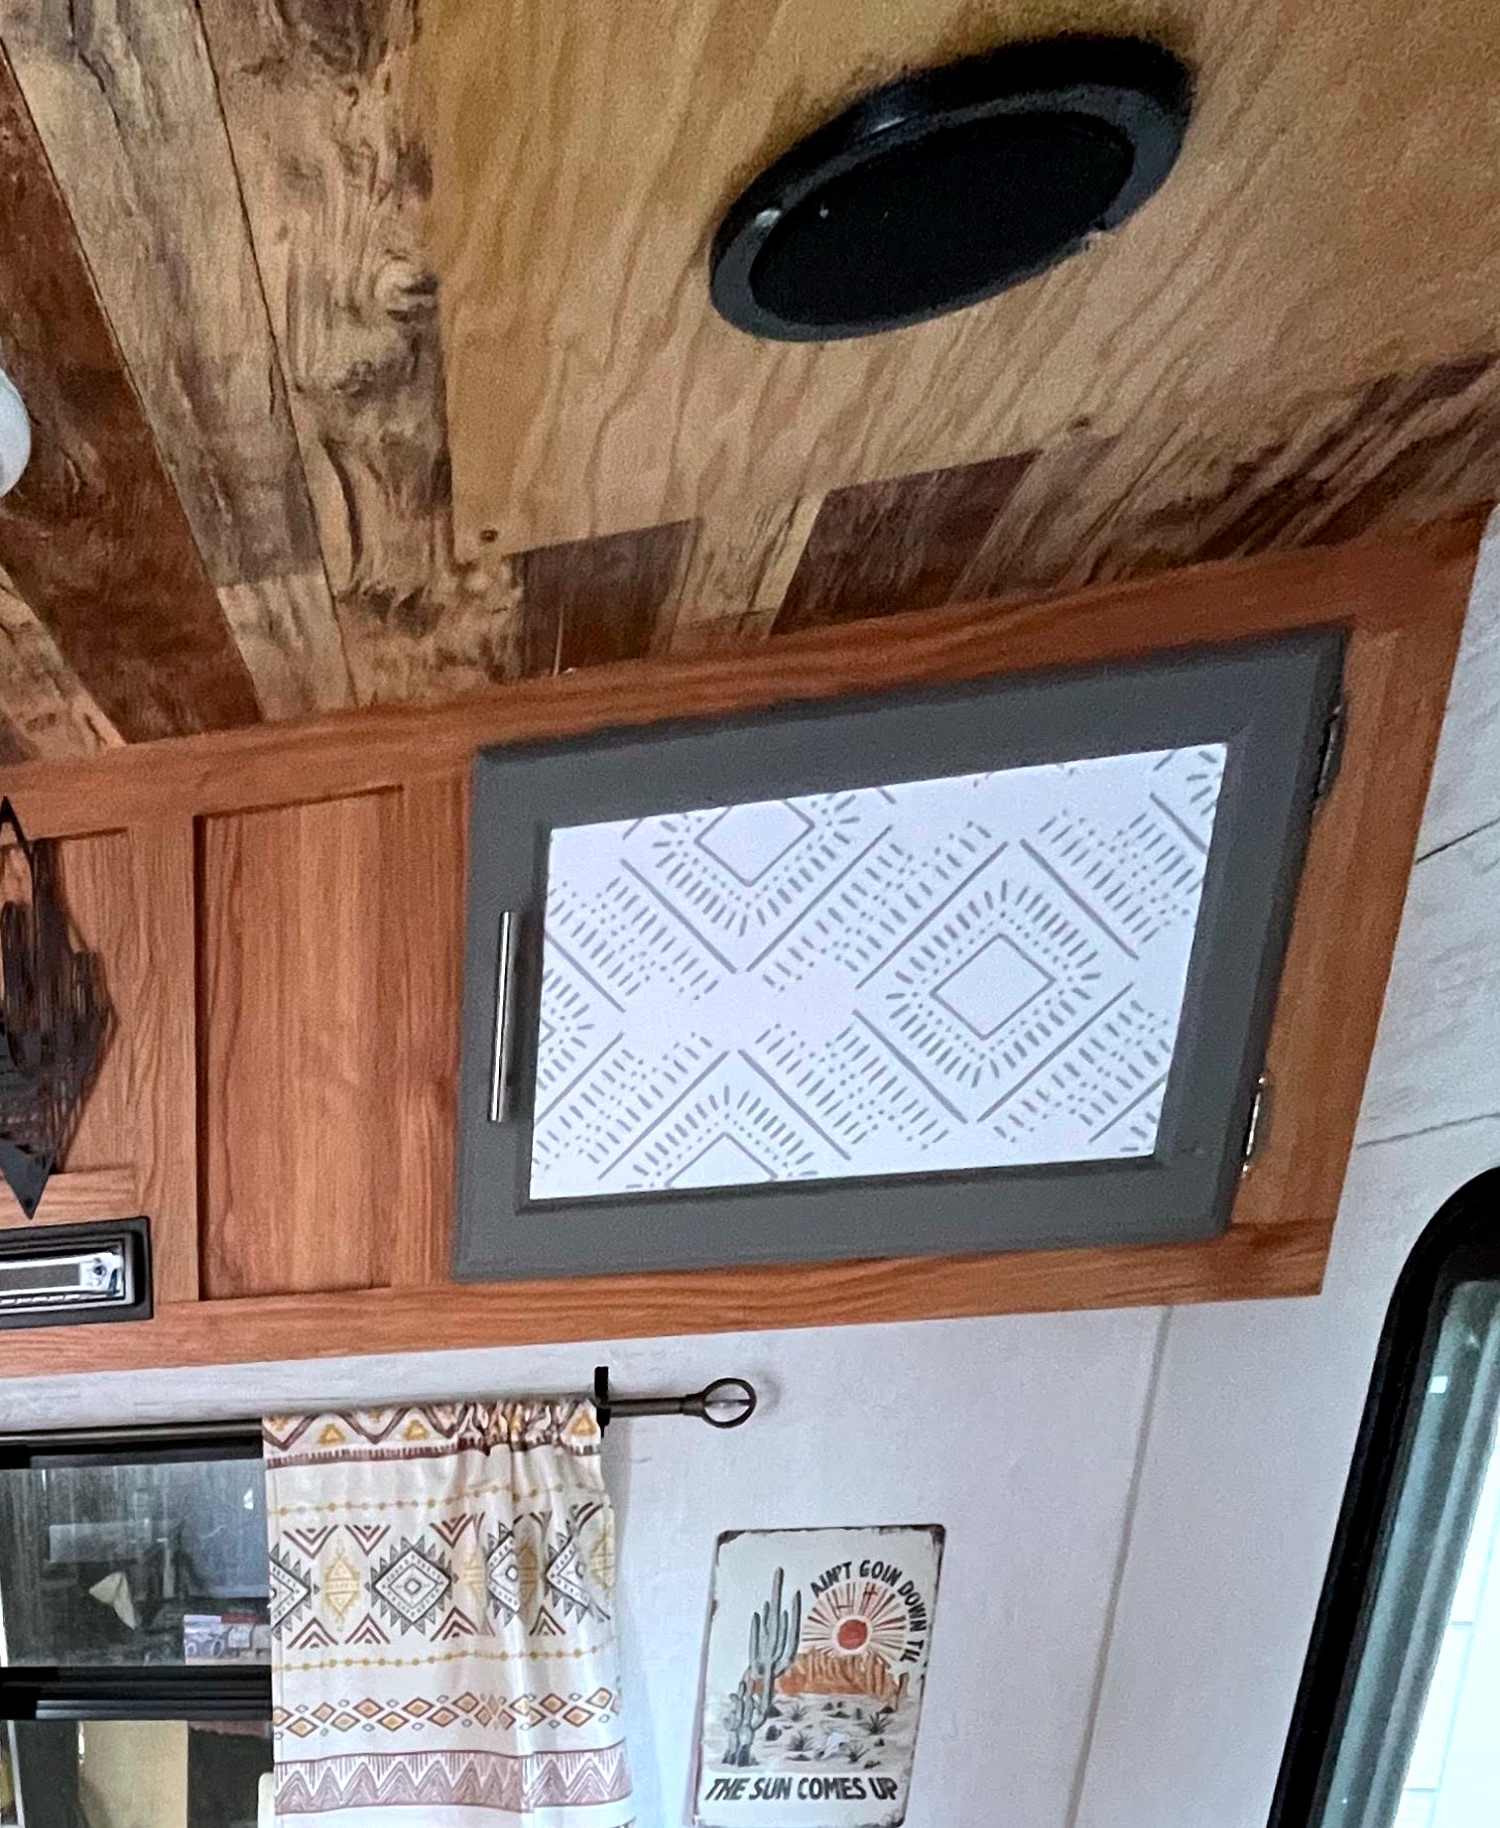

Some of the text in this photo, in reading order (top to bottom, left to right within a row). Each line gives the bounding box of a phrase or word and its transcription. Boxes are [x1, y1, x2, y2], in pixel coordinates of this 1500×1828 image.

[897, 1580, 927, 1632] DOWN
[704, 1777, 898, 1800] THE SUN COMES UP
